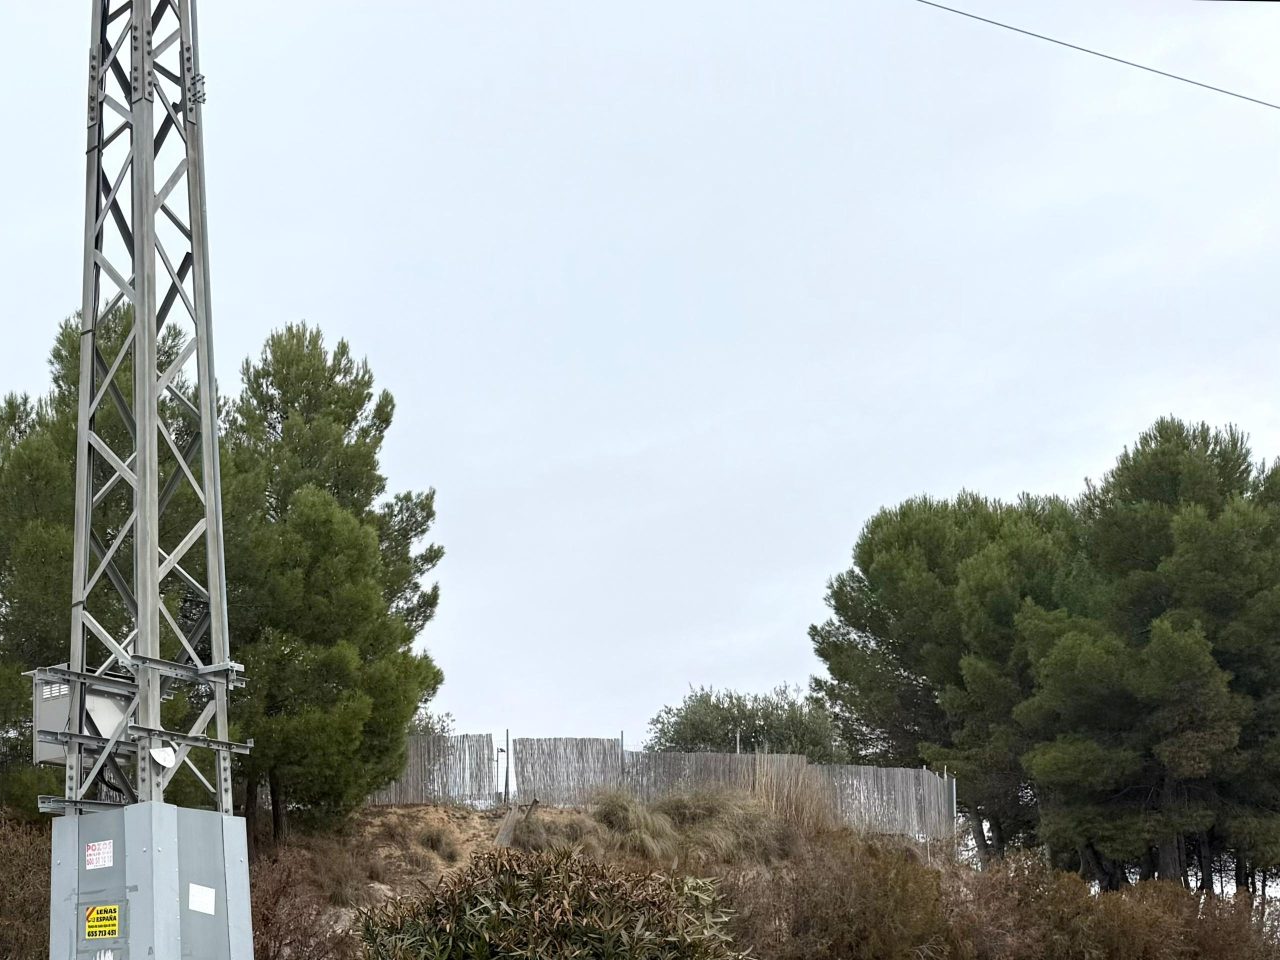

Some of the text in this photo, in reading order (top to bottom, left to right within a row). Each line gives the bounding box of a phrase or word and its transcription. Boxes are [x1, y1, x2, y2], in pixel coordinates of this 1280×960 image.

[86, 841, 112, 853] POZOS
[96, 907, 117, 915] LEÑAS
[96, 914, 117, 923] ESPAÑA
